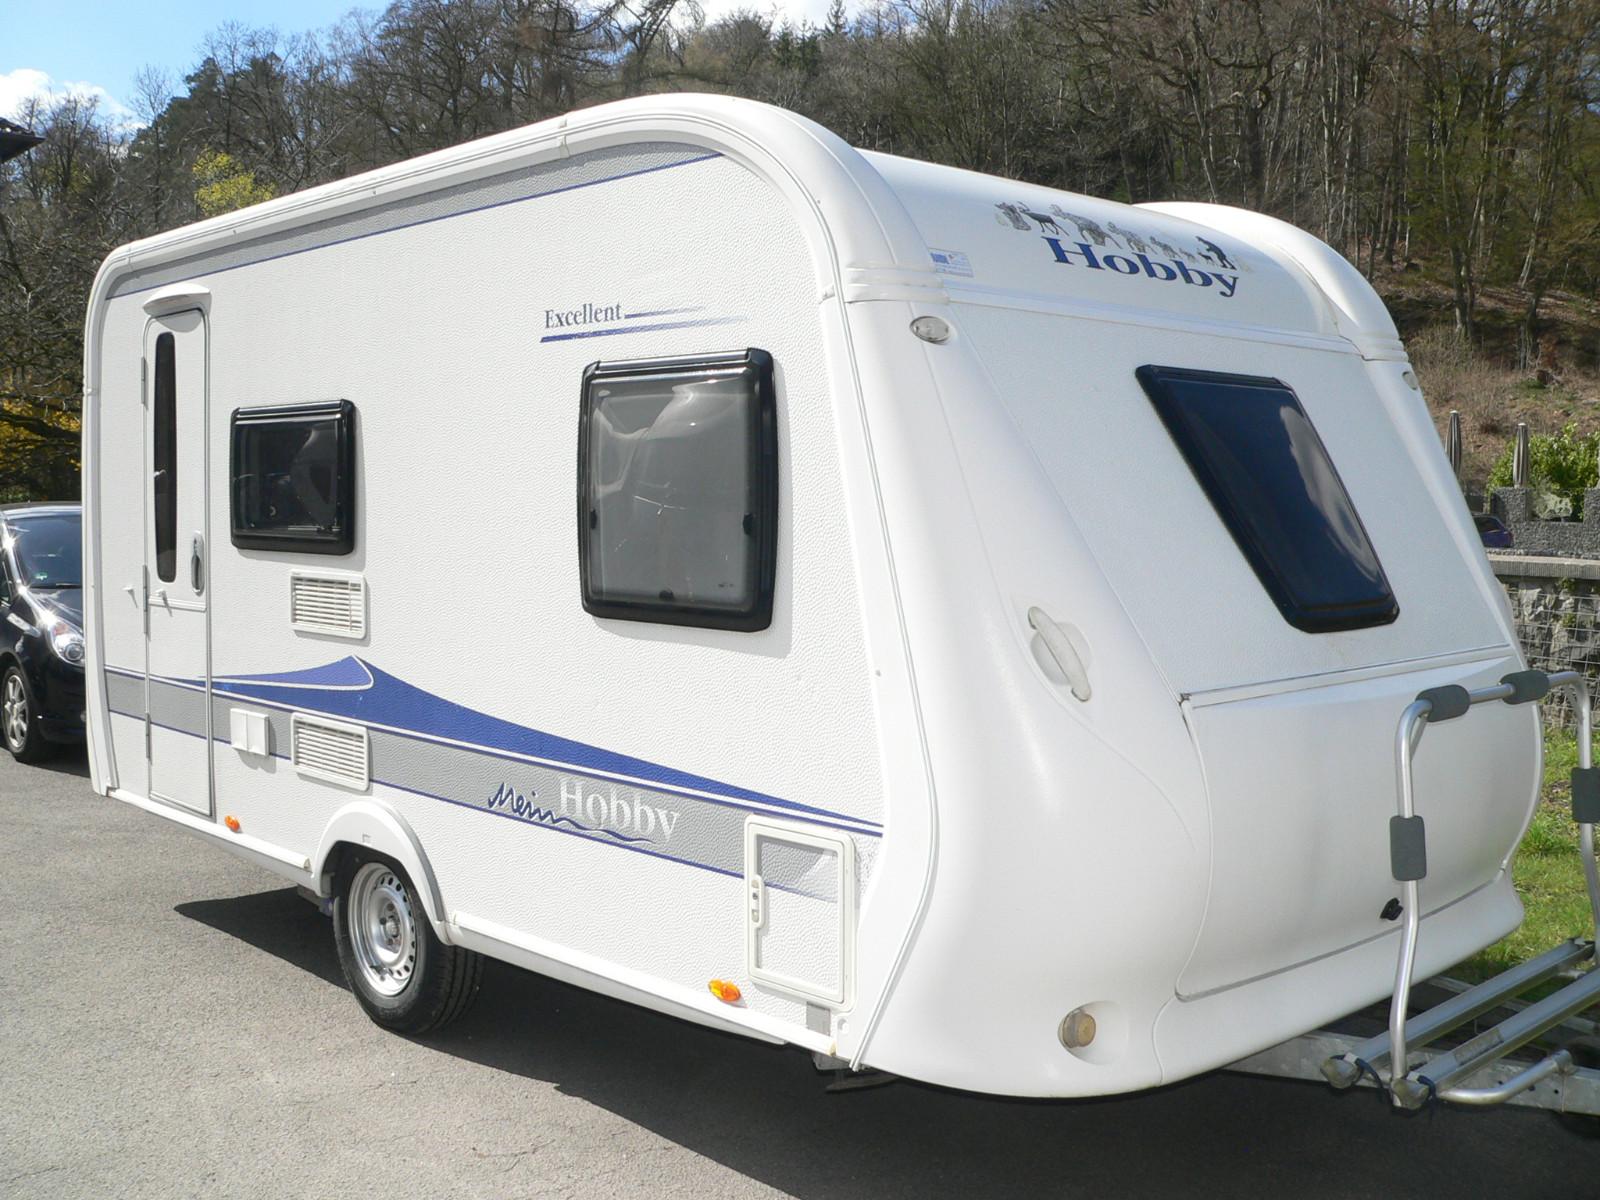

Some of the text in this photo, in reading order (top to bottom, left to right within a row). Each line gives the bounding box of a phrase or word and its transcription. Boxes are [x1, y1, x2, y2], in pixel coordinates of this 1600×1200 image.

[1041, 236, 1239, 298] Hobby
[544, 302, 622, 328] Excellent
[488, 778, 680, 841] Mein Hobby
